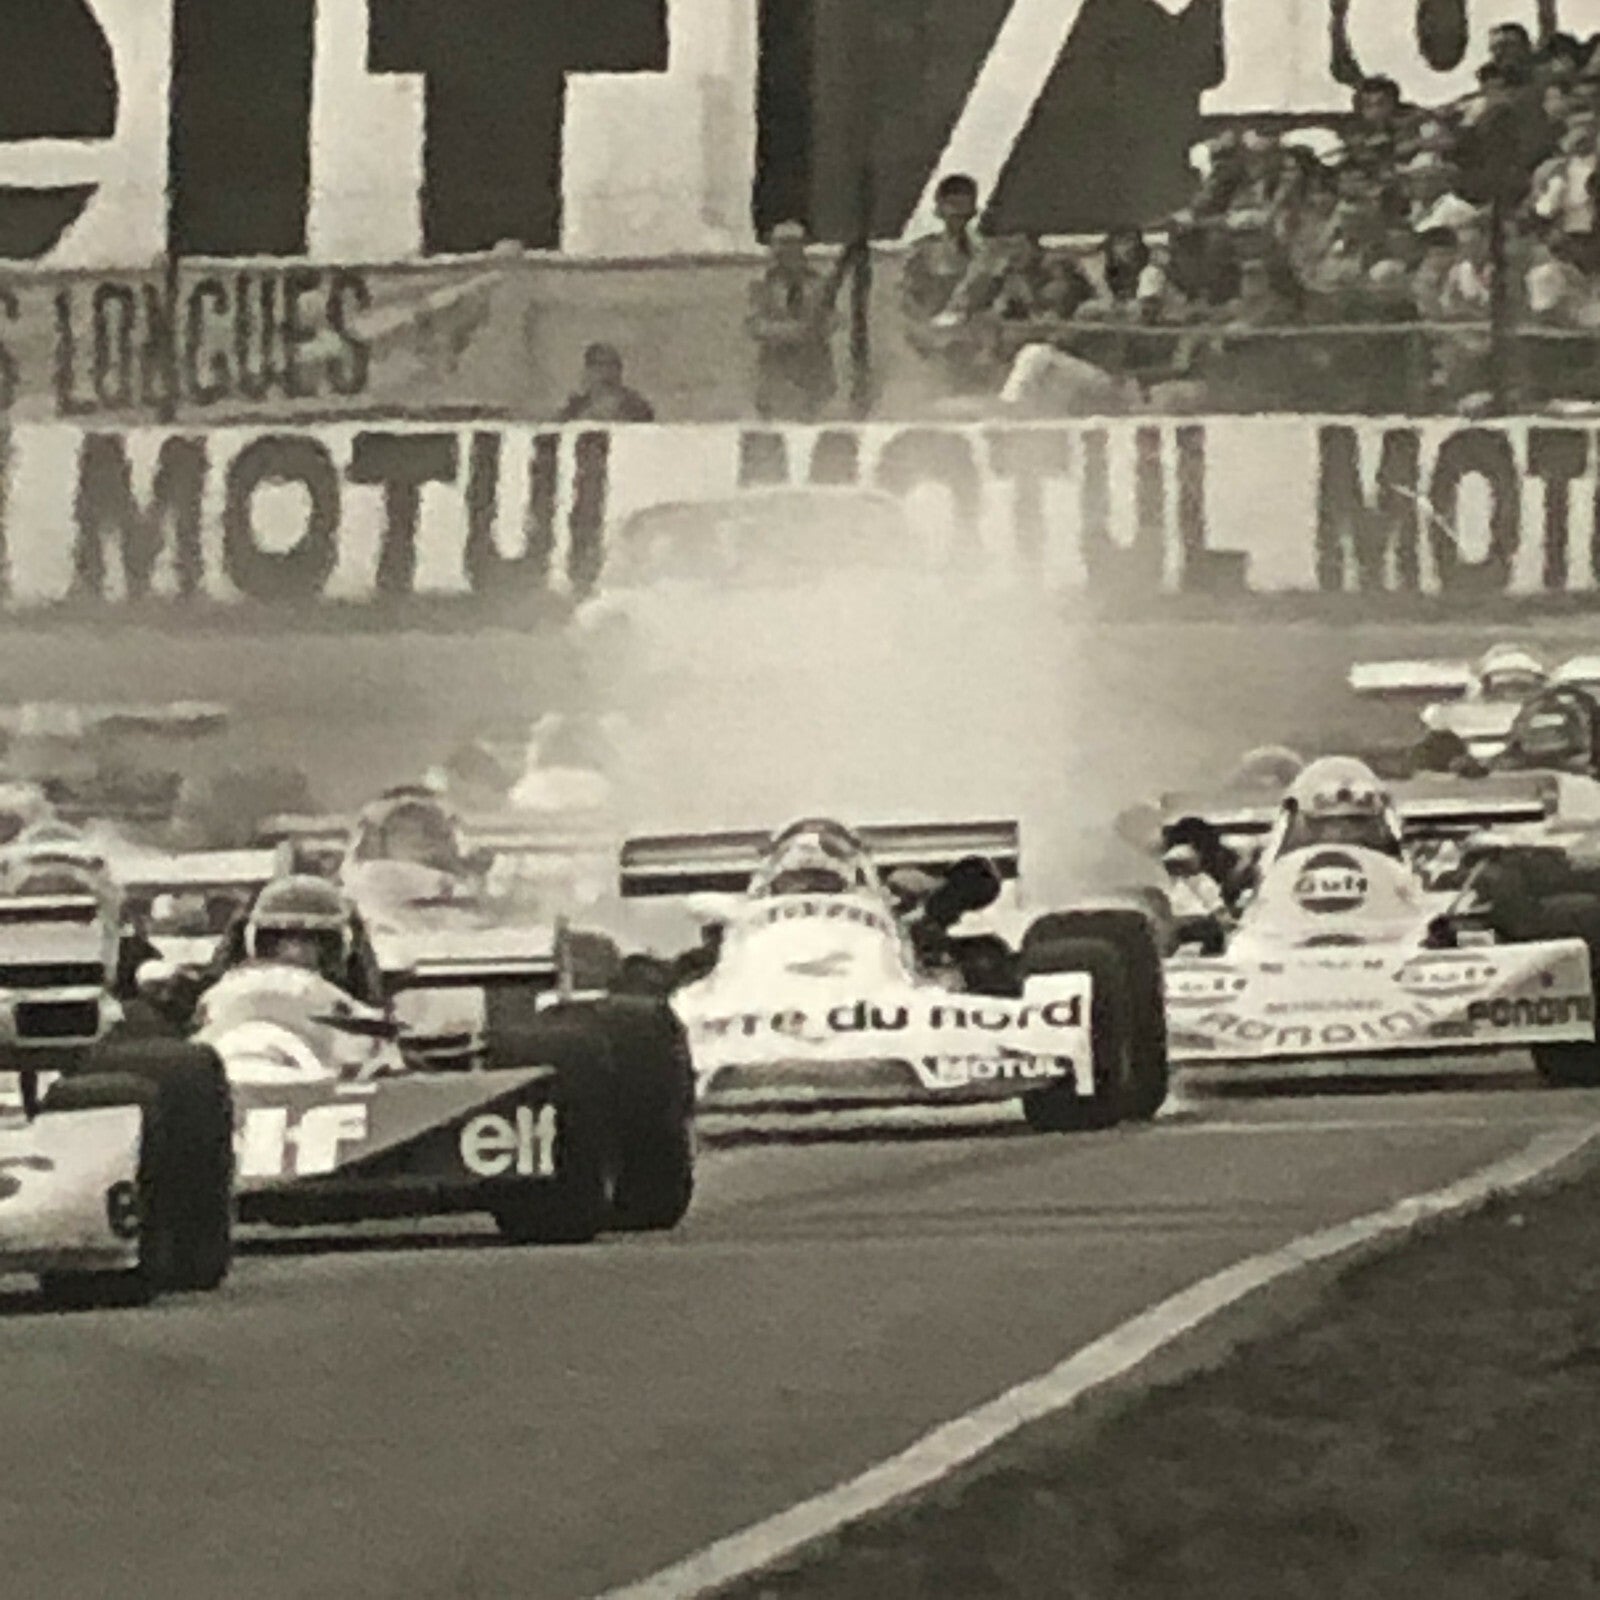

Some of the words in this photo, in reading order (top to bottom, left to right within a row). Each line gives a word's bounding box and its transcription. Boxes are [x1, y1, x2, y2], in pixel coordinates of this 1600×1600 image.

[1316, 425, 1600, 594] MOT
[828, 1000, 908, 1032] du
[928, 994, 1081, 1030] nord
[459, 1104, 557, 1177] elf
